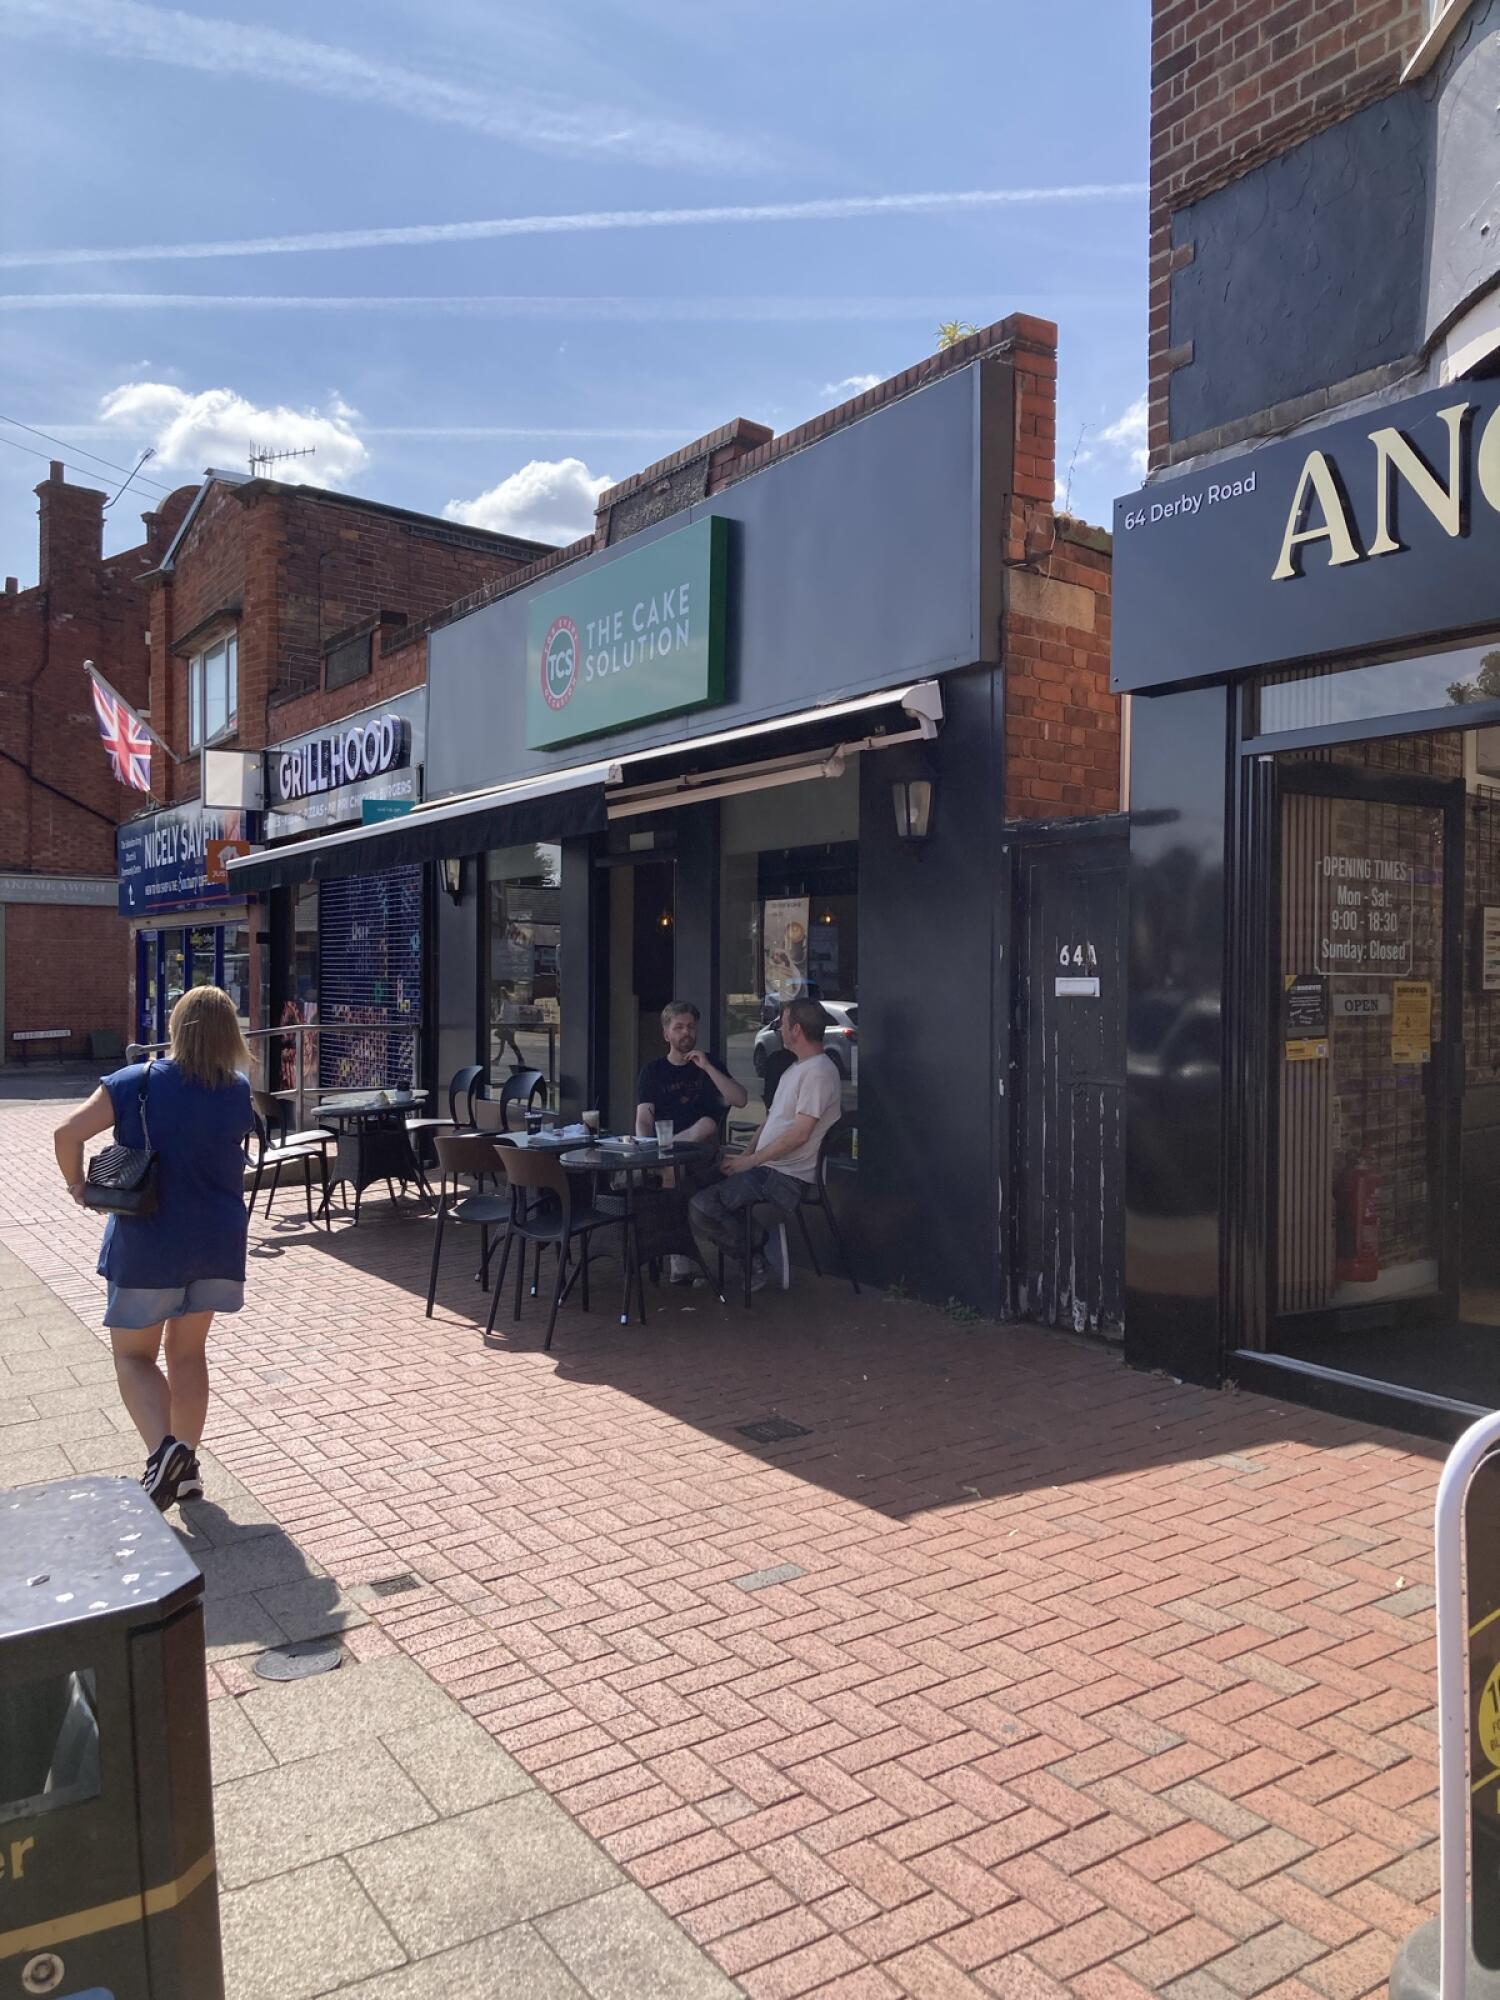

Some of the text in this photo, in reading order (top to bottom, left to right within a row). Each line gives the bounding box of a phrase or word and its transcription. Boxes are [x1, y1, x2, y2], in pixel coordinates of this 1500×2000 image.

[1124, 471, 1256, 530] 64 Derby Road
[1271, 402, 1500, 580] AN
[586, 584, 690, 650] THE CAKE
[549, 648, 573, 681] TCS
[586, 619, 689, 681] SOLUTION
[280, 714, 400, 800] GRILLHOOD
[144, 824, 179, 870] NICELY
[1324, 856, 1407, 881] OPENING TIMES
[1337, 885, 1361, 906] Mon
[1332, 910, 1357, 931] 9:00
[1368, 912, 1398, 932] 18:30
[1322, 938, 1406, 963] Sunday: Closed
[1344, 999, 1379, 1012] OPEN
[0, 1837, 35, 1880] r
